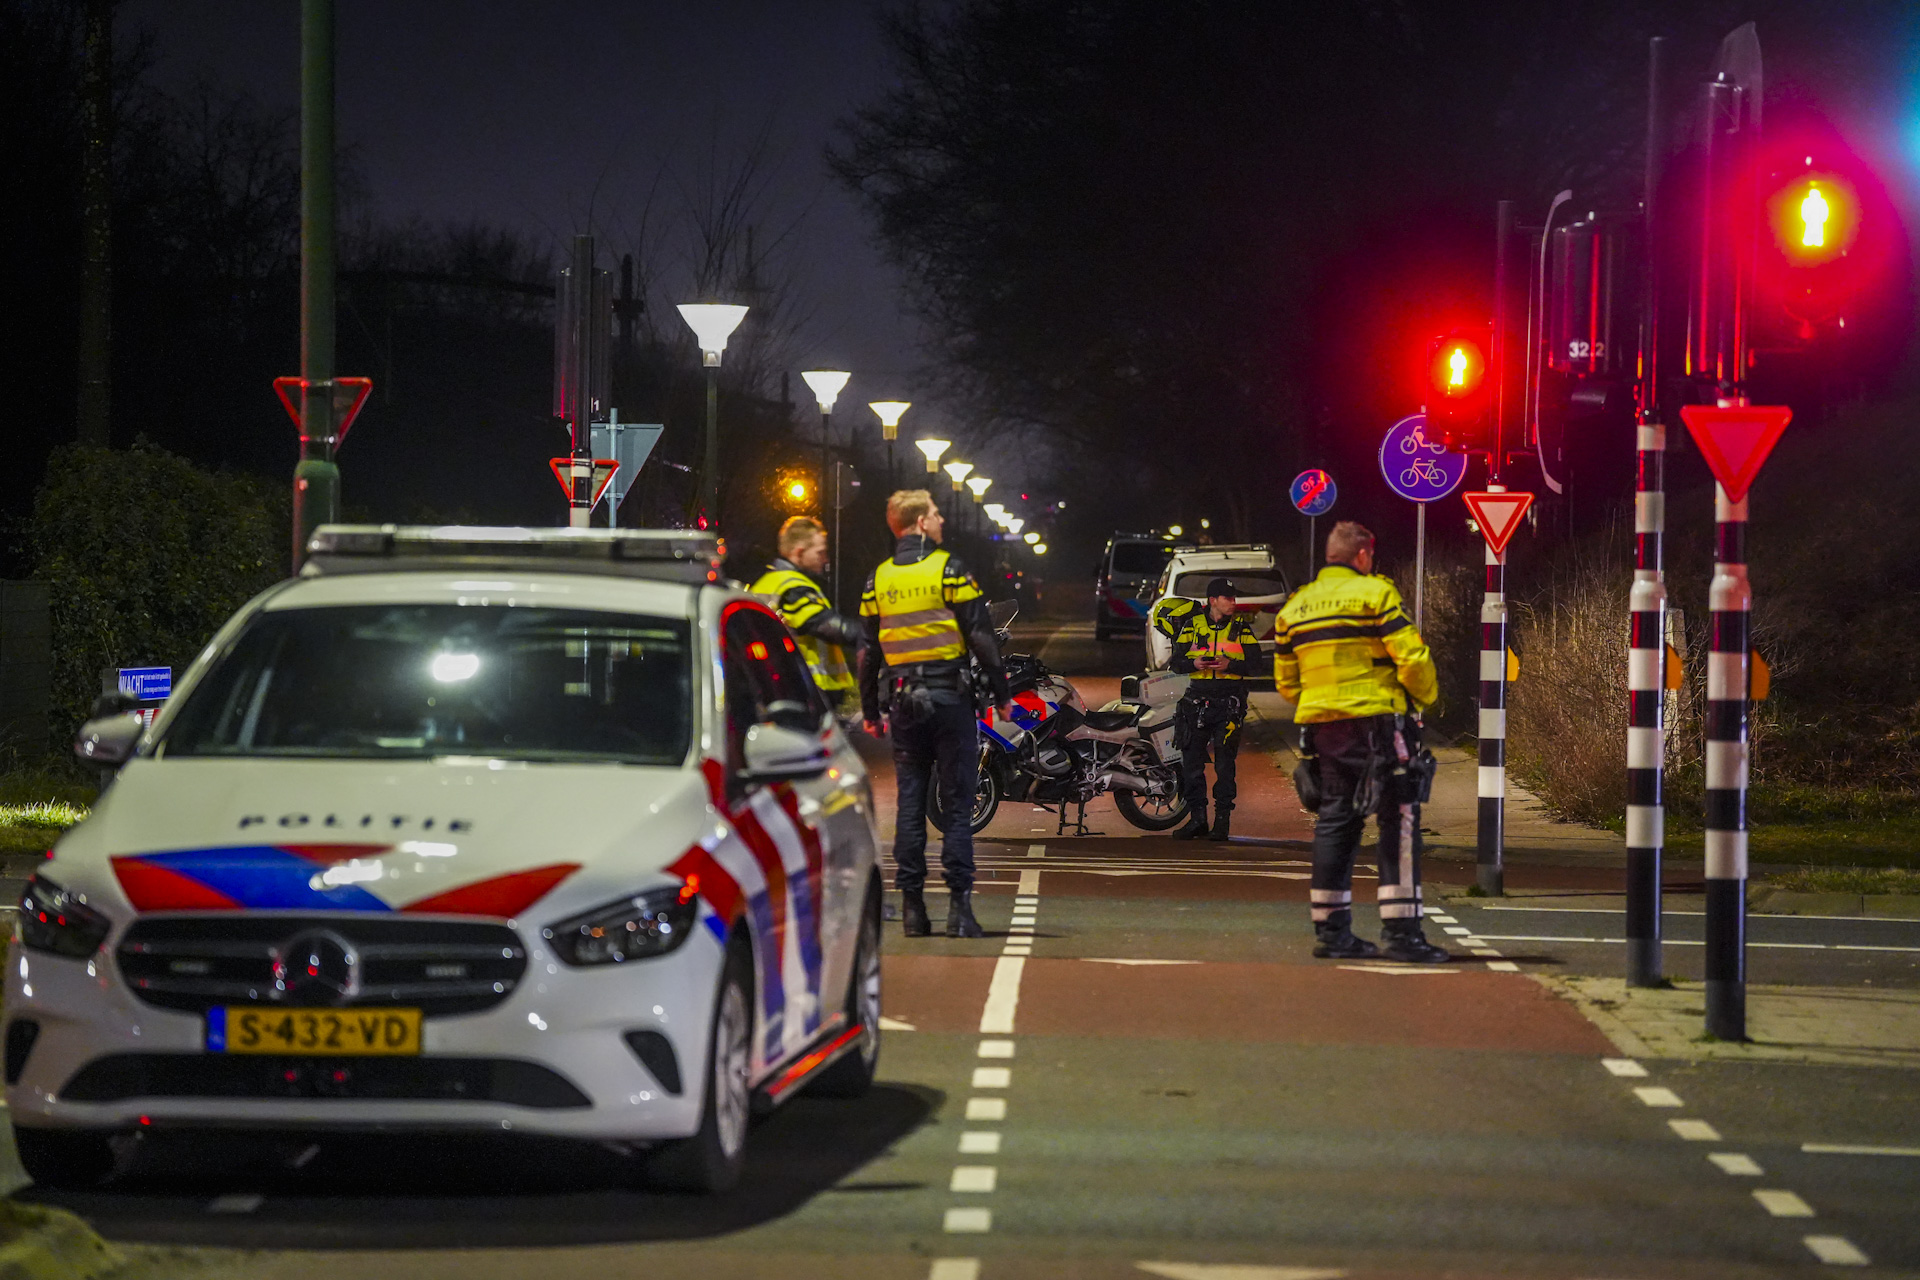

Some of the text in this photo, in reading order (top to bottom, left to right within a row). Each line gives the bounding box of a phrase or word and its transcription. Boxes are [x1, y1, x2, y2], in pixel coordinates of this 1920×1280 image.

[119, 675, 145, 694] WACHT
[237, 811, 474, 836] POLITIE
[238, 1013, 409, 1048] S-432-VD
